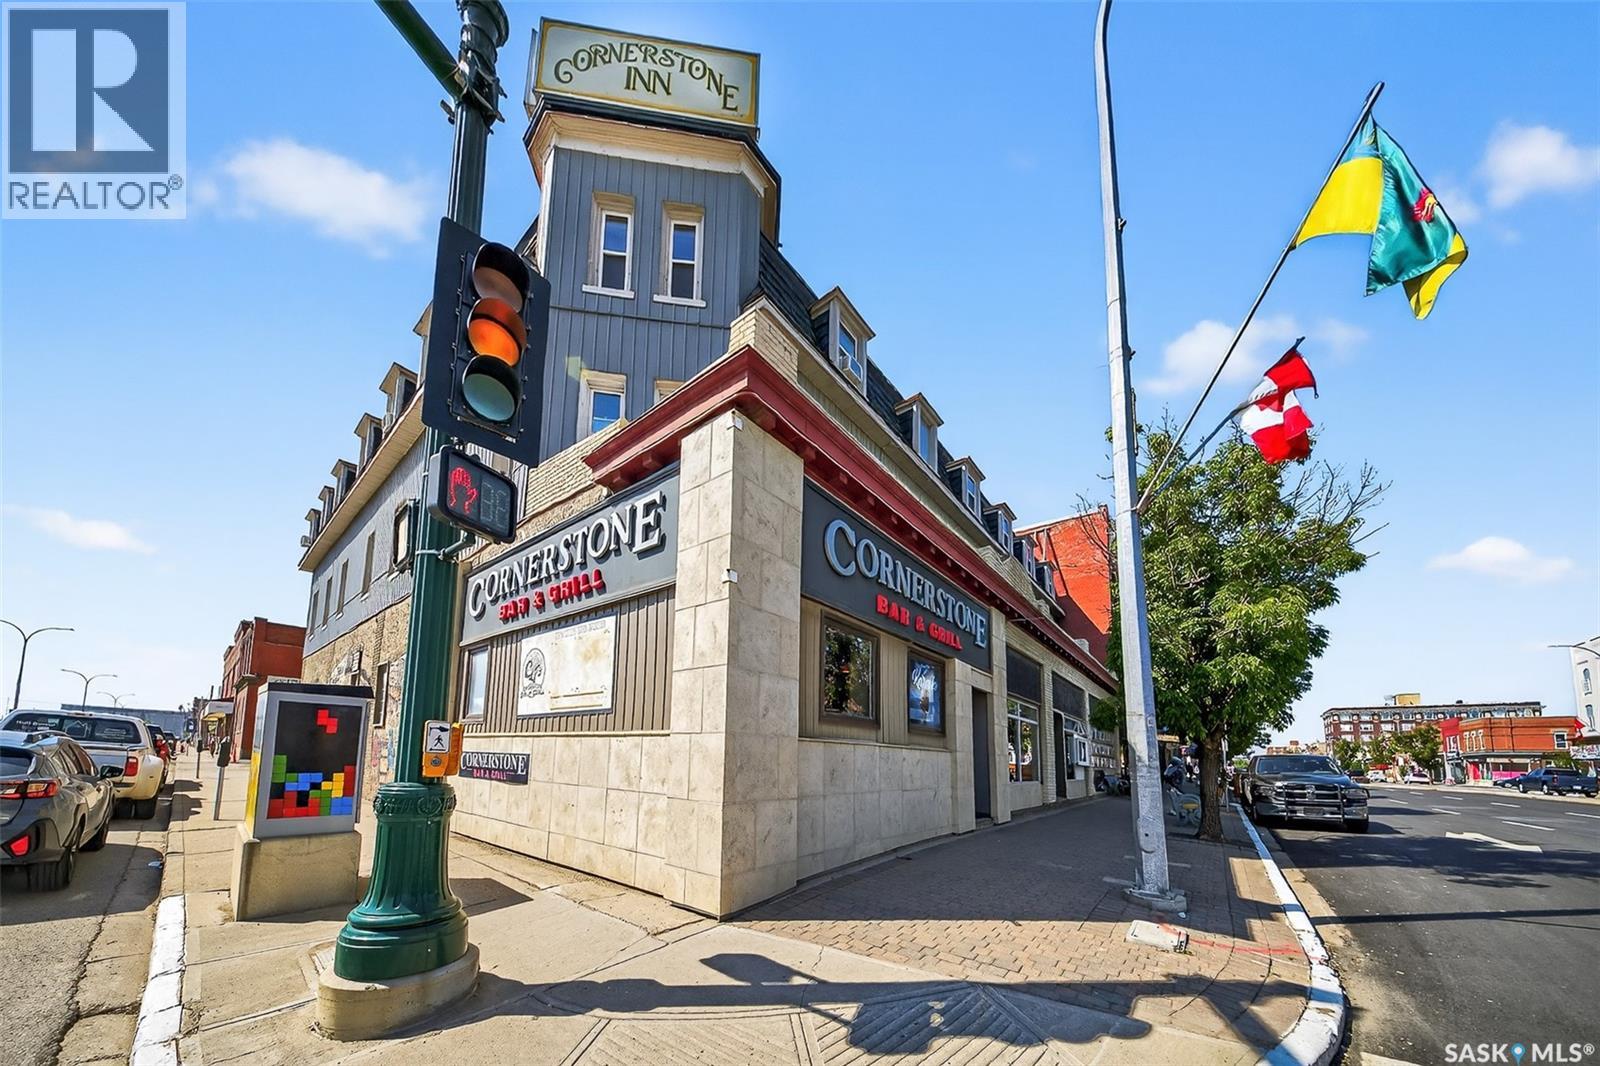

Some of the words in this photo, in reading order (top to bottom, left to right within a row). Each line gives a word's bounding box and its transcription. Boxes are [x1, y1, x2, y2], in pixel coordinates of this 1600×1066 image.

[553, 42, 740, 112] CORNERSTONE
[623, 66, 672, 96] INN
[468, 490, 665, 618] CORNERSTONE
[498, 597, 530, 620] BAR
[532, 591, 546, 609] &
[547, 568, 605, 604] GRILL
[824, 519, 987, 649] CORNERSTONE
[876, 593, 911, 626] BAR
[914, 615, 926, 633] &
[928, 622, 964, 650] GRILL
[460, 753, 527, 775] CORNERSTONE
